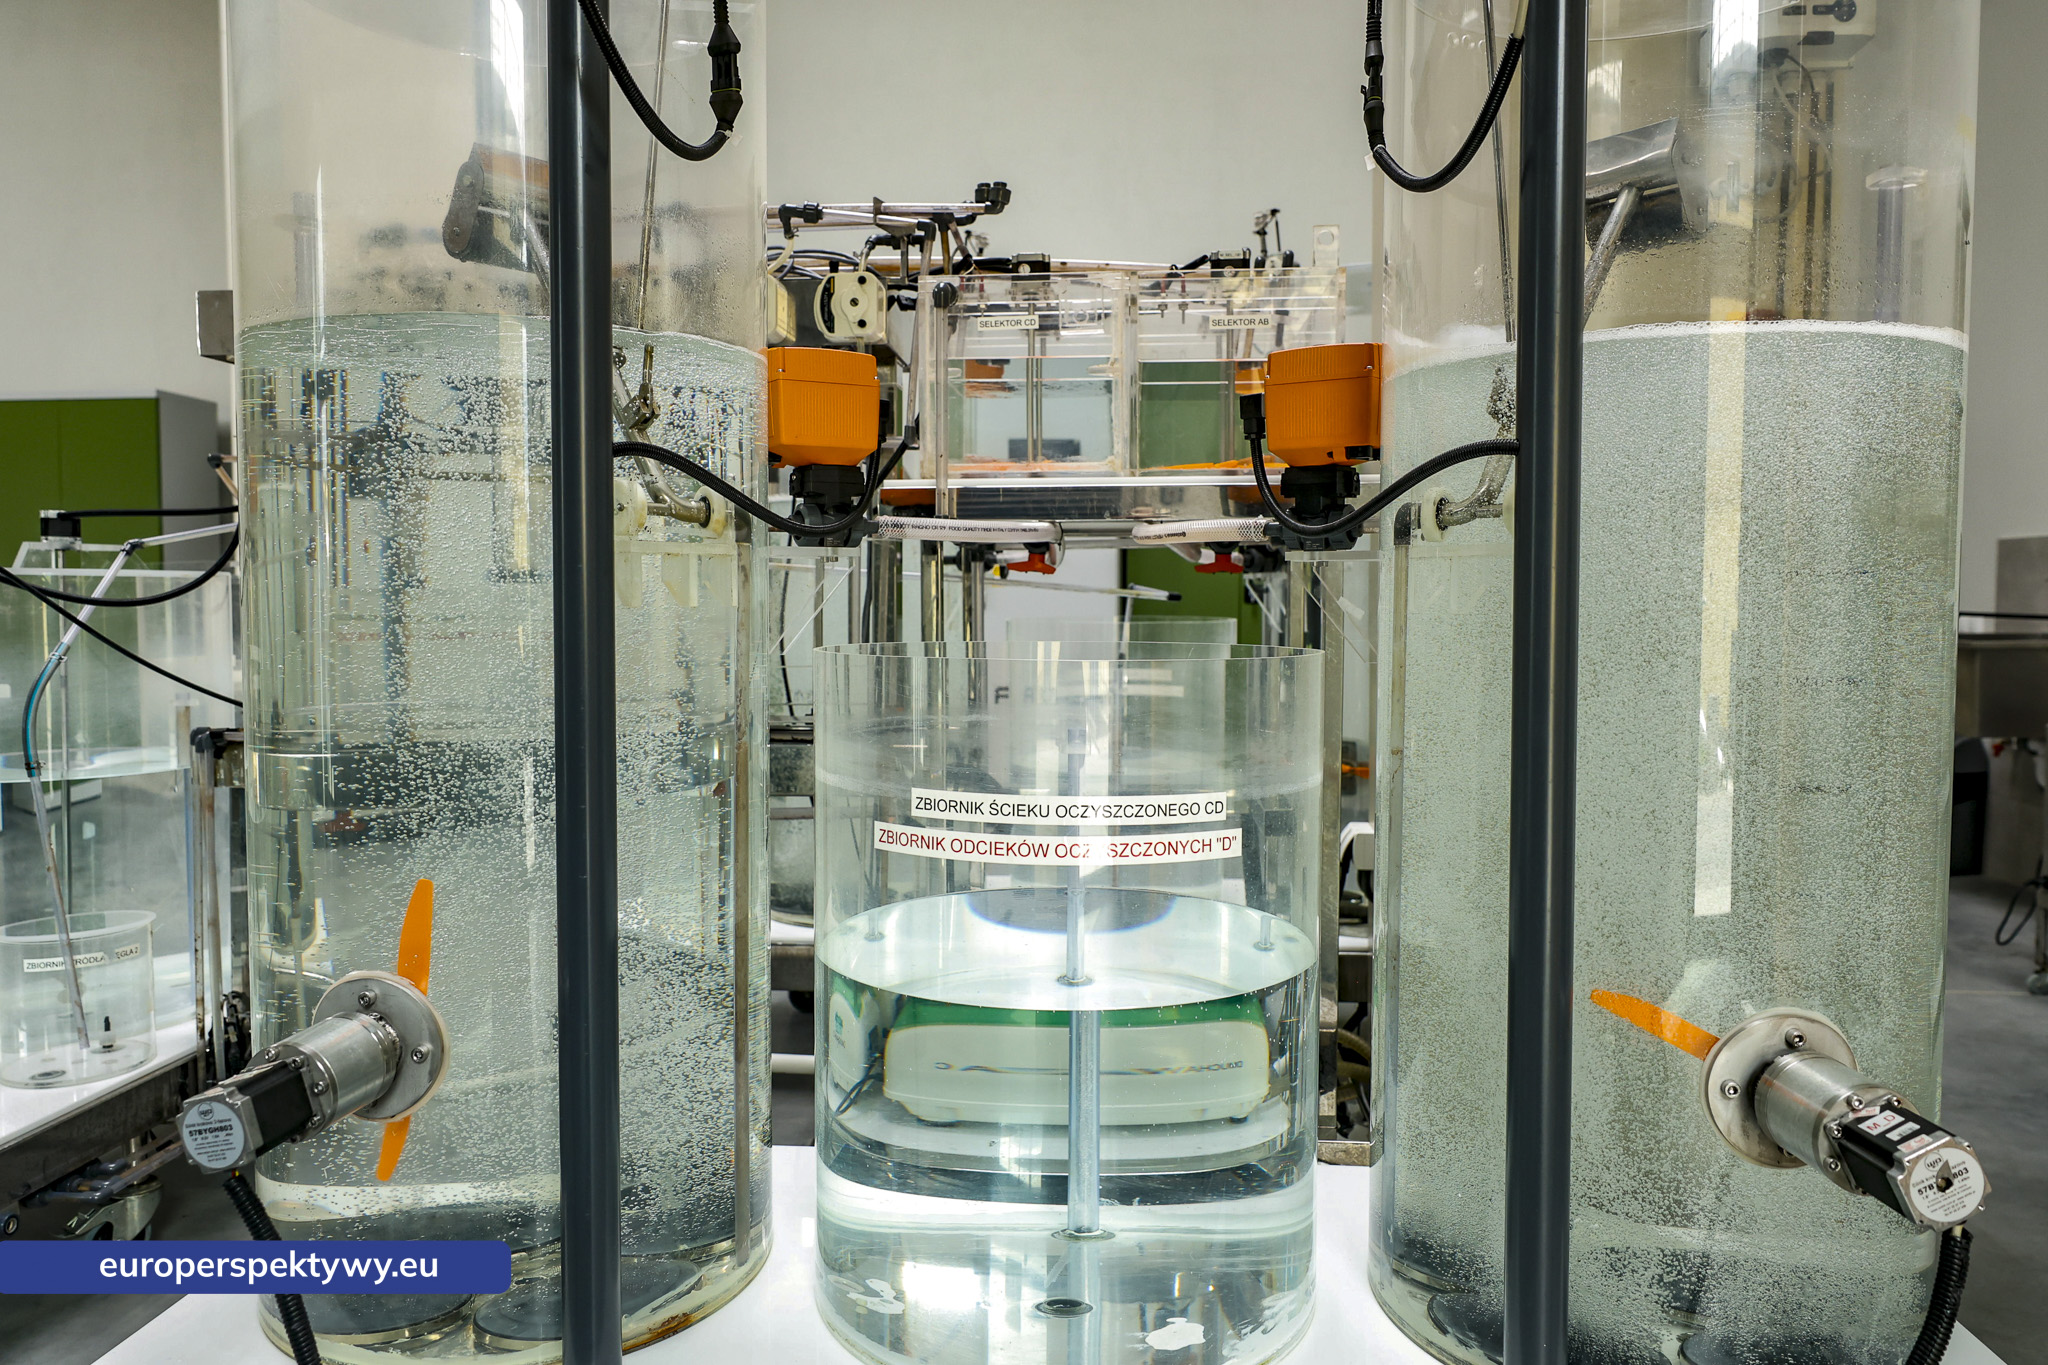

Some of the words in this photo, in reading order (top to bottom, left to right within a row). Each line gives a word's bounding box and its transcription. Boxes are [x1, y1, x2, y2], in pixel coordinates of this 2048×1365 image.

[979, 319, 1022, 328] SELEKTOR
[1024, 318, 1036, 326] CD
[1211, 318, 1255, 327] SELEKTOR
[1257, 318, 1269, 326] AB
[915, 796, 985, 815] ZBIORNIK
[988, 799, 1050, 818] ŚCIEKU
[1055, 802, 1201, 818] OCZYSZCZONEGO
[1204, 800, 1224, 814] CD
[878, 828, 946, 852] ZBIORNIK
[950, 838, 1050, 858] ODCIEKÓW
[1055, 838, 1212, 858] OCZSZCZONYCH
[1216, 835, 1237, 851] "D"
